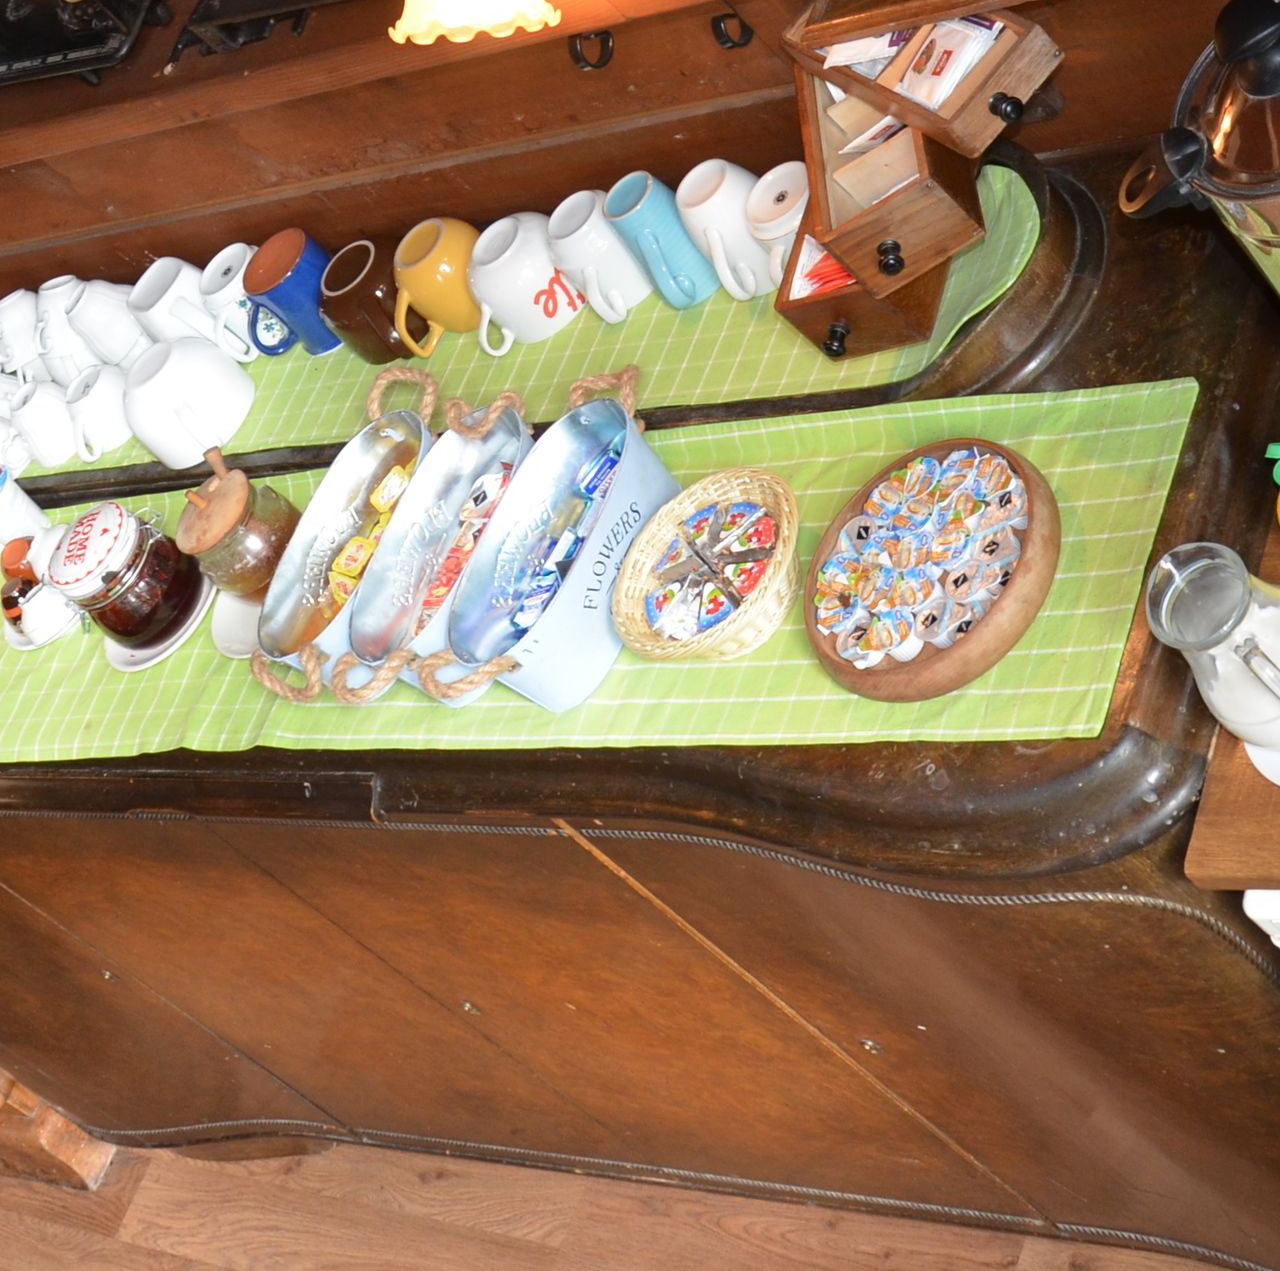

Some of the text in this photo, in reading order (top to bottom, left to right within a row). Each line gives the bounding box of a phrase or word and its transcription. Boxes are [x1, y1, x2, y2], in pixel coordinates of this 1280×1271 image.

[63, 515, 87, 567] MADE
[73, 510, 103, 566] HOME
[583, 502, 642, 609] FLOWERS
